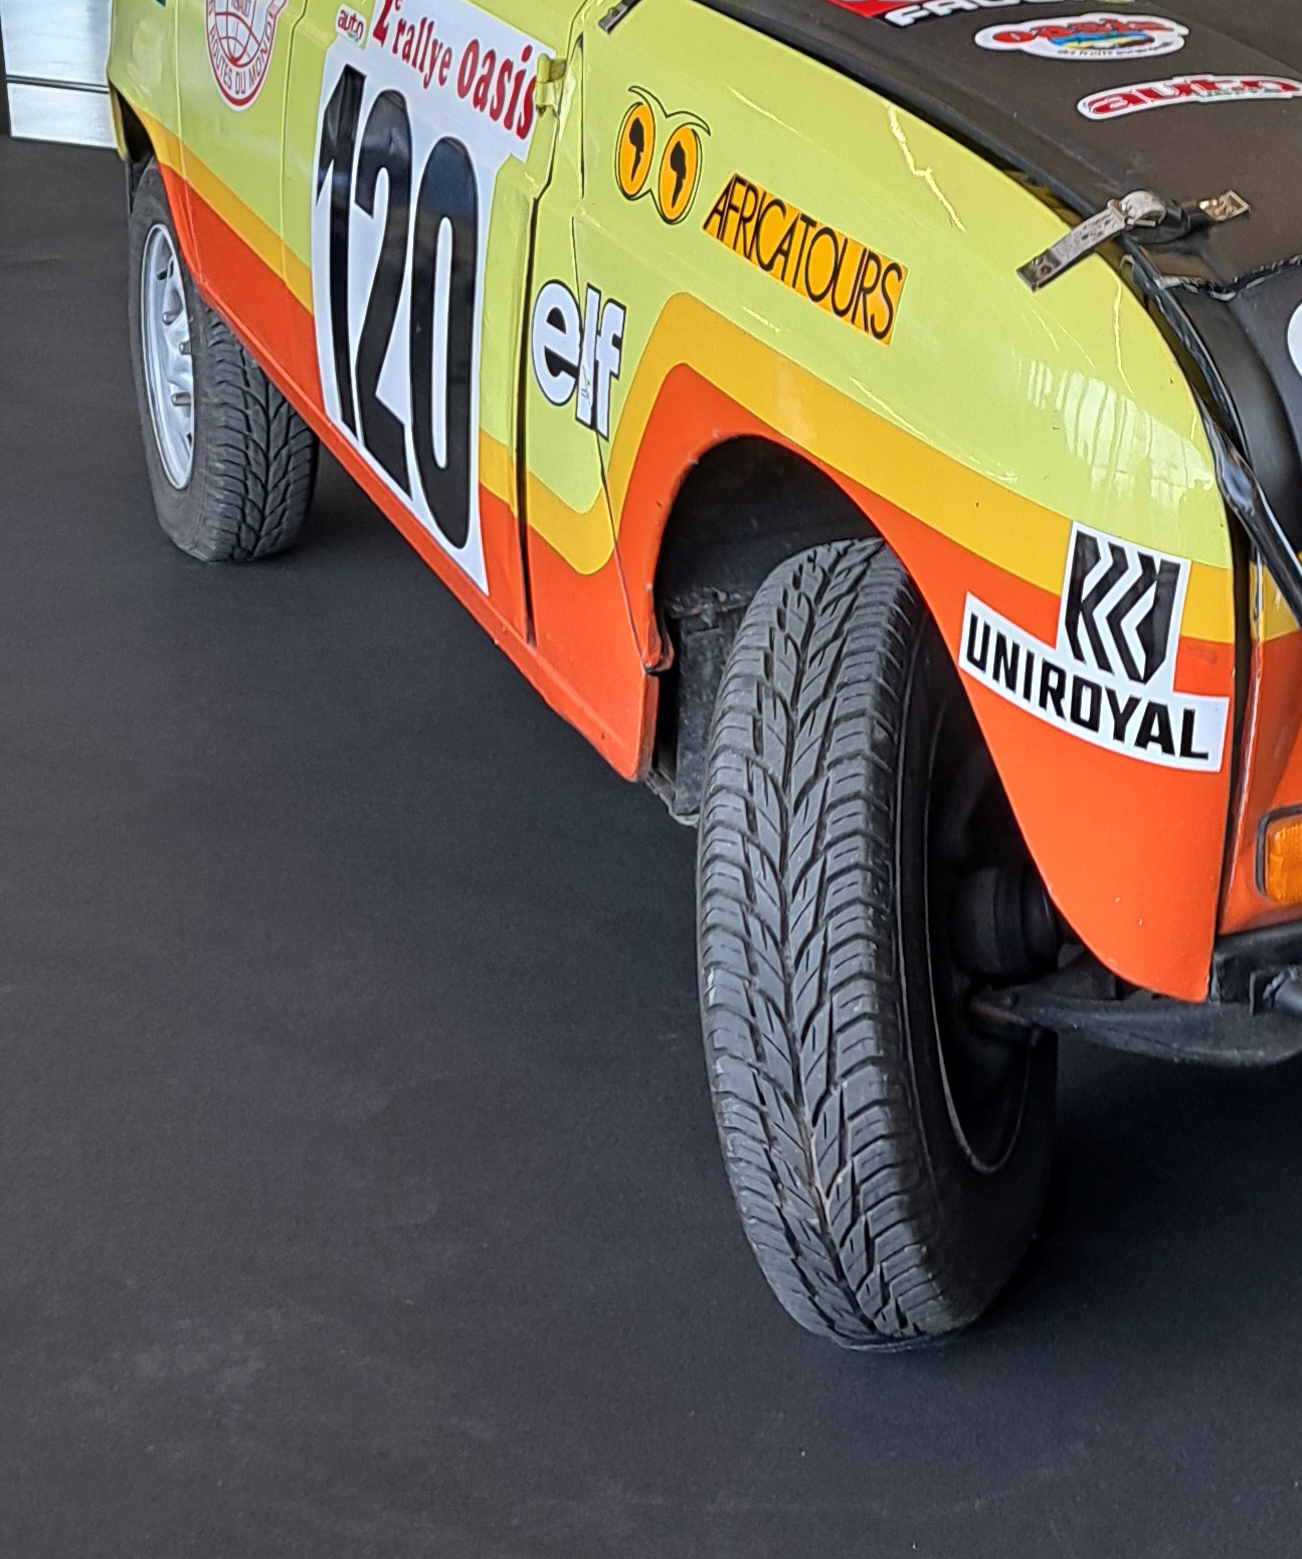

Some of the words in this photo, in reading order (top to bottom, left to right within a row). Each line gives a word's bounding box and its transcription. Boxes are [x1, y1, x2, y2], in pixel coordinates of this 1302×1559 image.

[235, 70, 247, 95] DU
[391, 17, 453, 90] rallye
[316, 63, 478, 550] 120
[702, 173, 904, 341] AFRICATOURS
[531, 279, 628, 441] elf
[966, 611, 1210, 761] UNIROYAL
